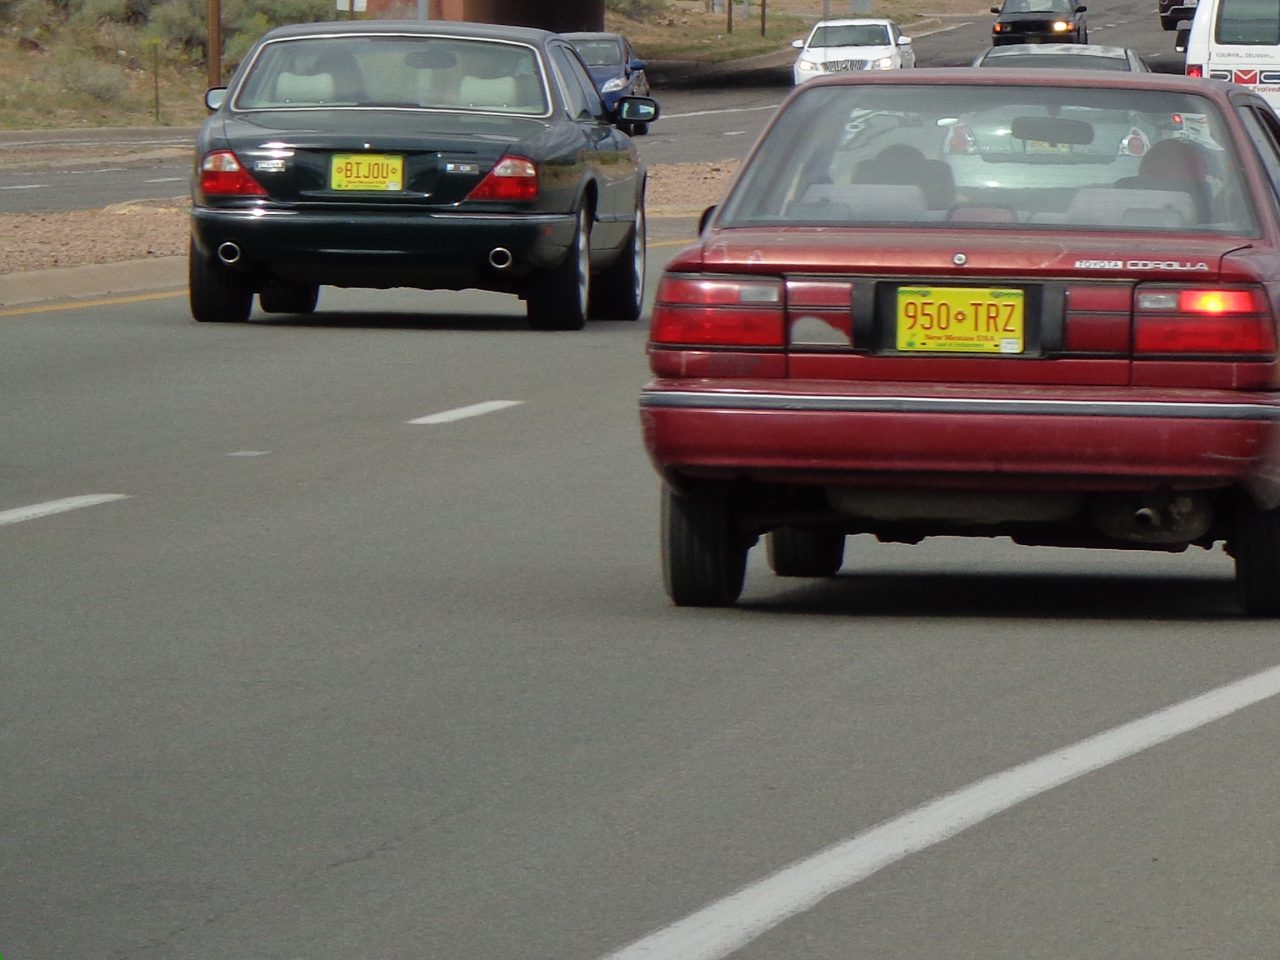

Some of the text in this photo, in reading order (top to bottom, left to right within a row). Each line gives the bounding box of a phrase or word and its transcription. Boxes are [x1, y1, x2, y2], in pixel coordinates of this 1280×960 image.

[345, 161, 389, 179] BIJOU
[1075, 260, 1208, 271] TOYOTA COROLLA
[904, 301, 1016, 332] 950 TRZ
